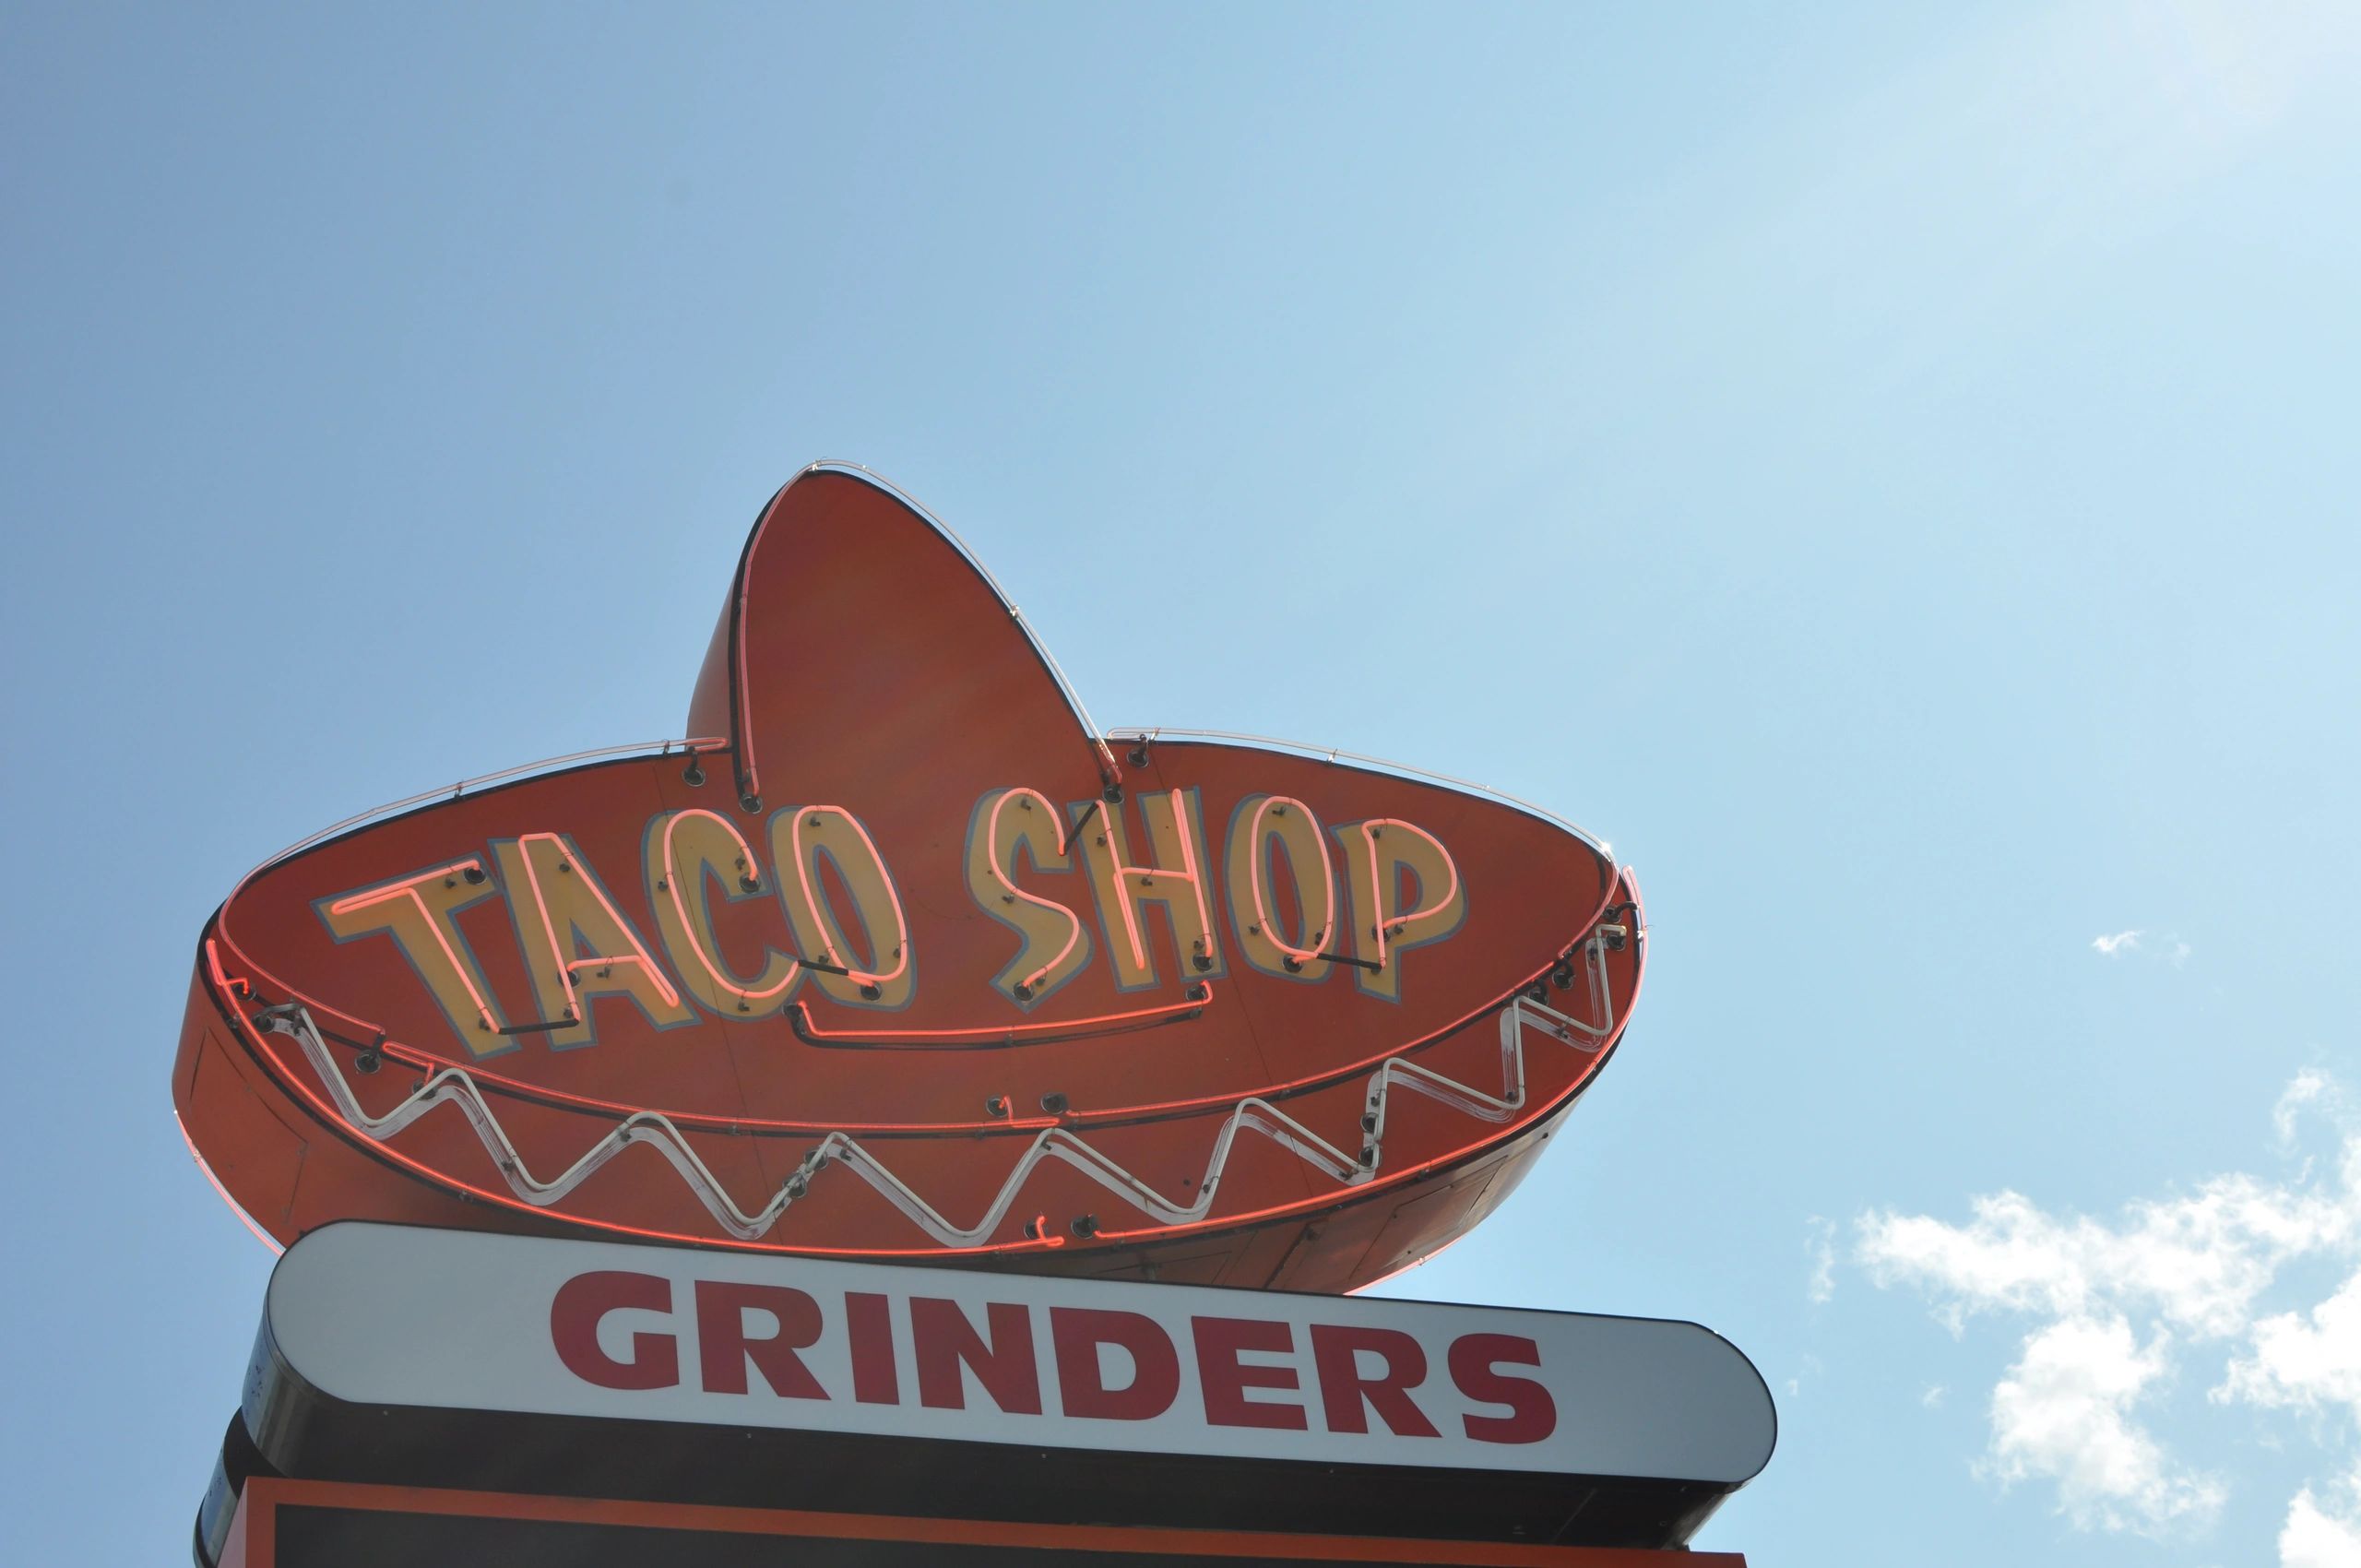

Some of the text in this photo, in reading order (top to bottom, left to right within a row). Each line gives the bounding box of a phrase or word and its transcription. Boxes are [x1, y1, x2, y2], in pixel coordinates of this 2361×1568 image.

[310, 786, 1467, 1061] TACO SHOP
[551, 1270, 1557, 1444] GRINDERS
